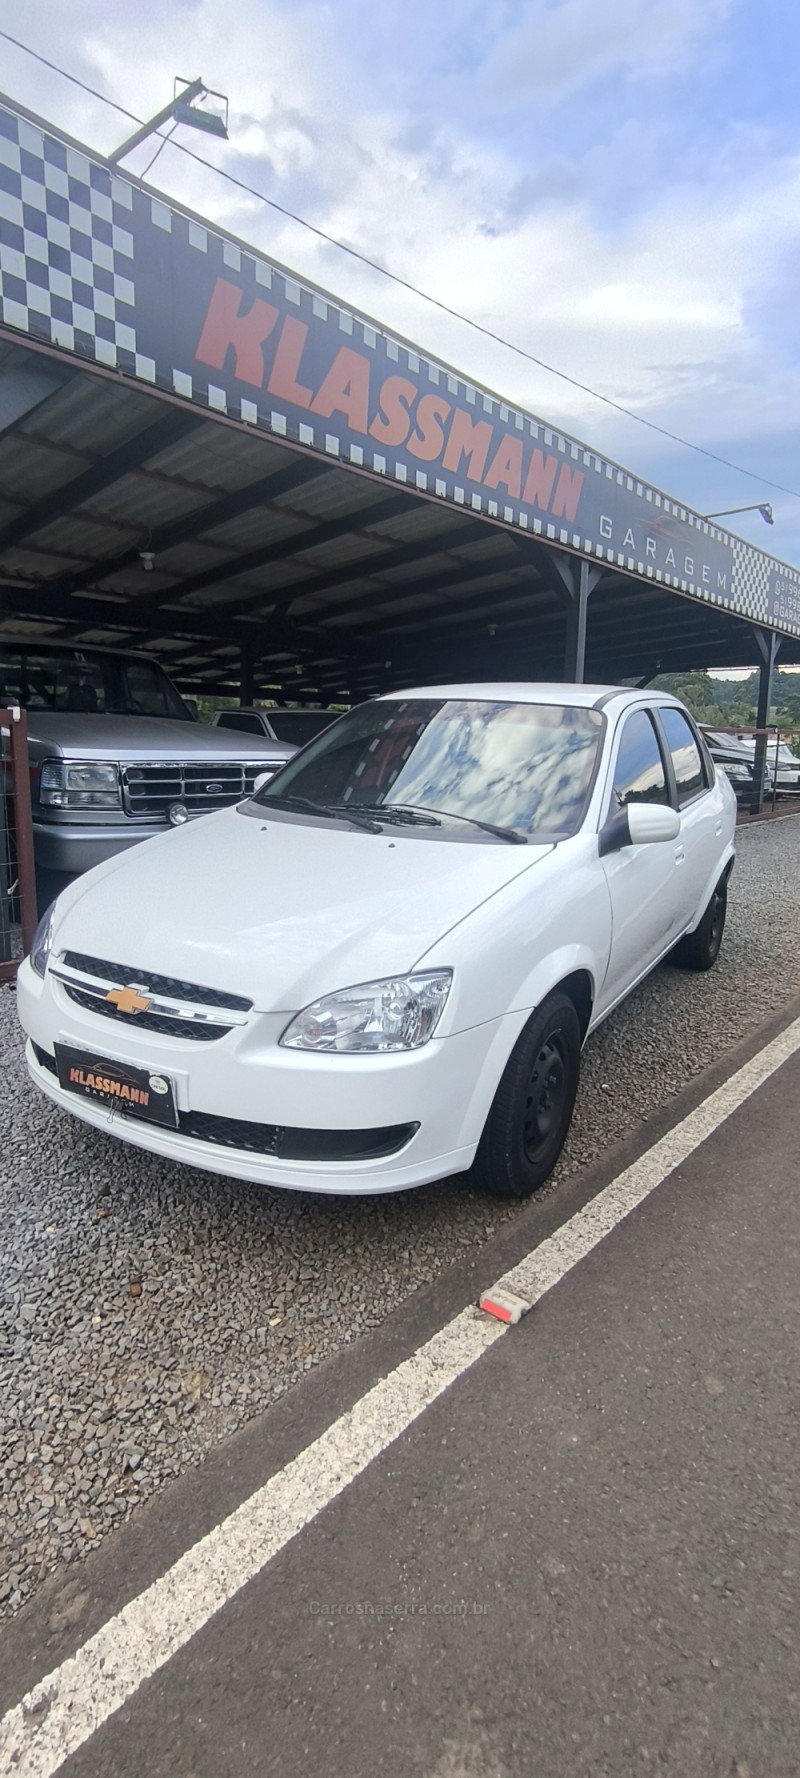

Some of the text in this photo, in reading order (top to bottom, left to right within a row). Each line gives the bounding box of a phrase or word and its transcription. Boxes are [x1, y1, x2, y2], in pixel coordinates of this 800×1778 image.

[195, 277, 585, 523] KLASSMANN
[599, 515, 727, 590] GARAGEM
[70, 1067, 149, 1106] KLASSMANN
